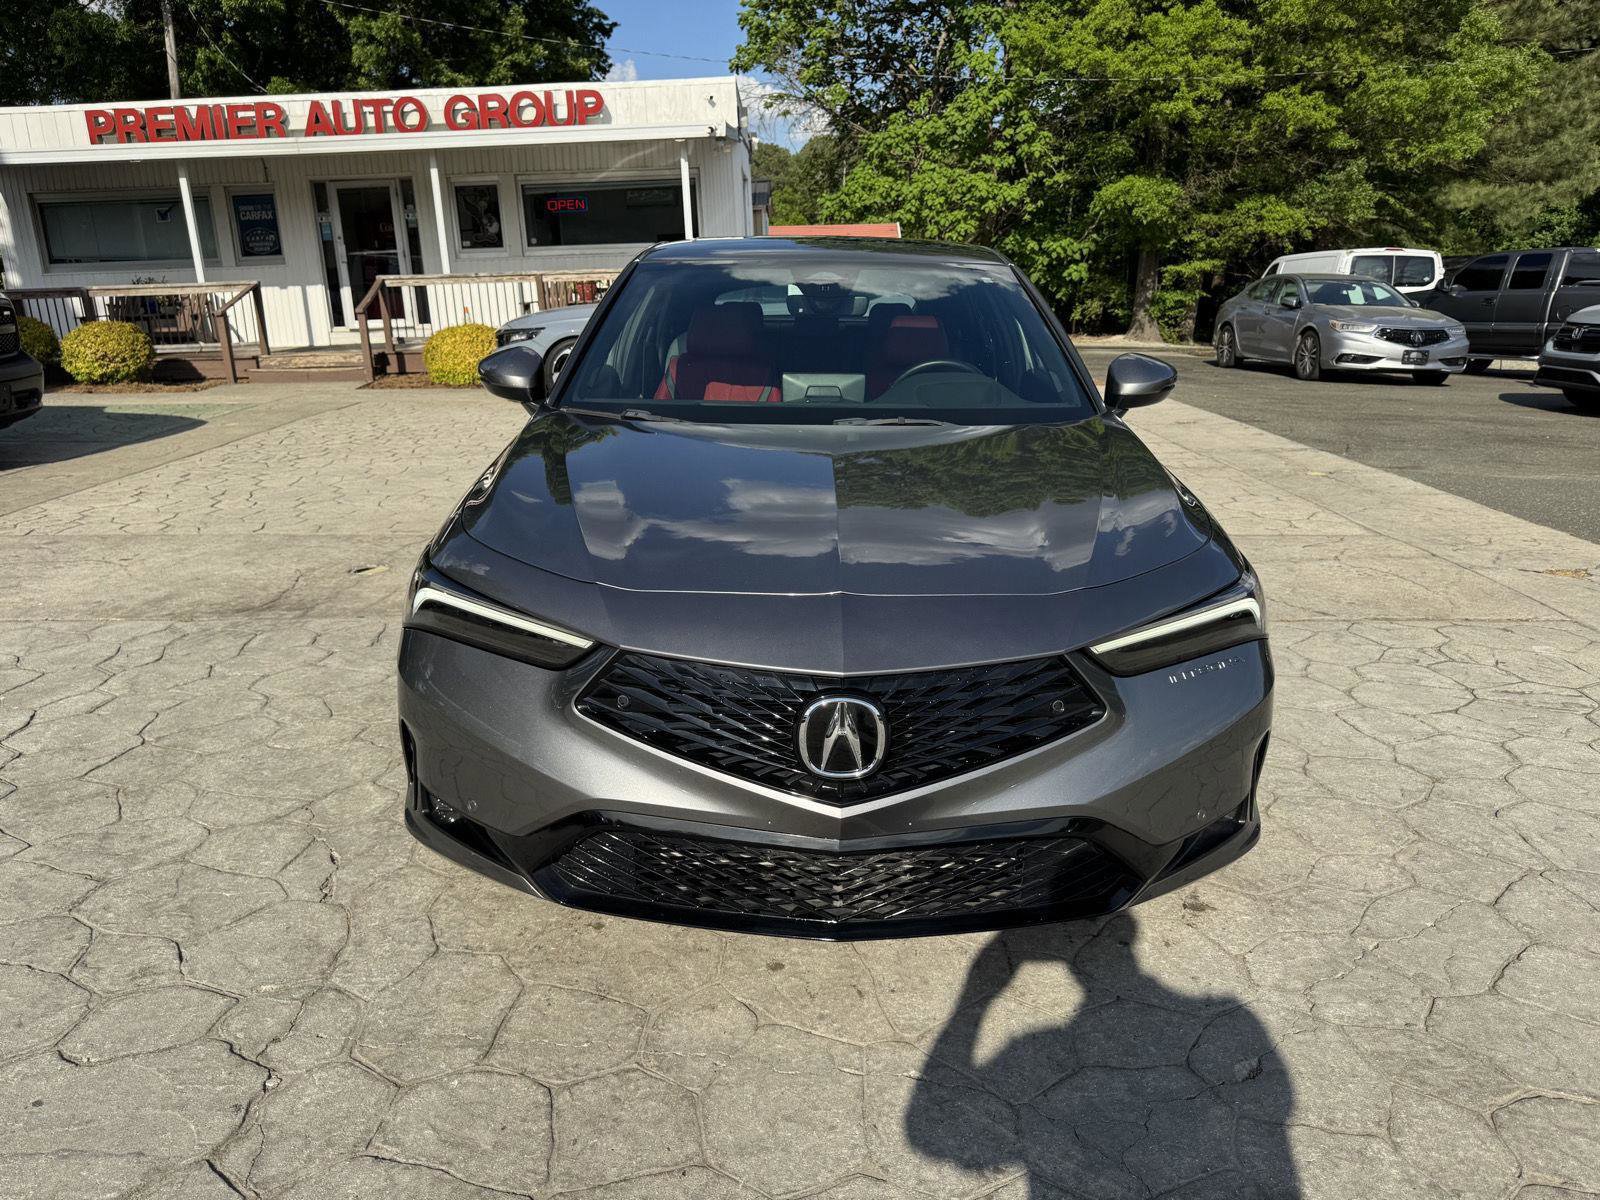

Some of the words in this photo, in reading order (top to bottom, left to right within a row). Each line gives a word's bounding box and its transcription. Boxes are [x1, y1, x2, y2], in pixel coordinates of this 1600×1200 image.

[85, 101, 287, 144] PREMIER
[304, 96, 428, 137] AUTO
[444, 89, 604, 131] GROUP
[547, 199, 585, 211] OPEN
[240, 210, 273, 220] CARFAX
